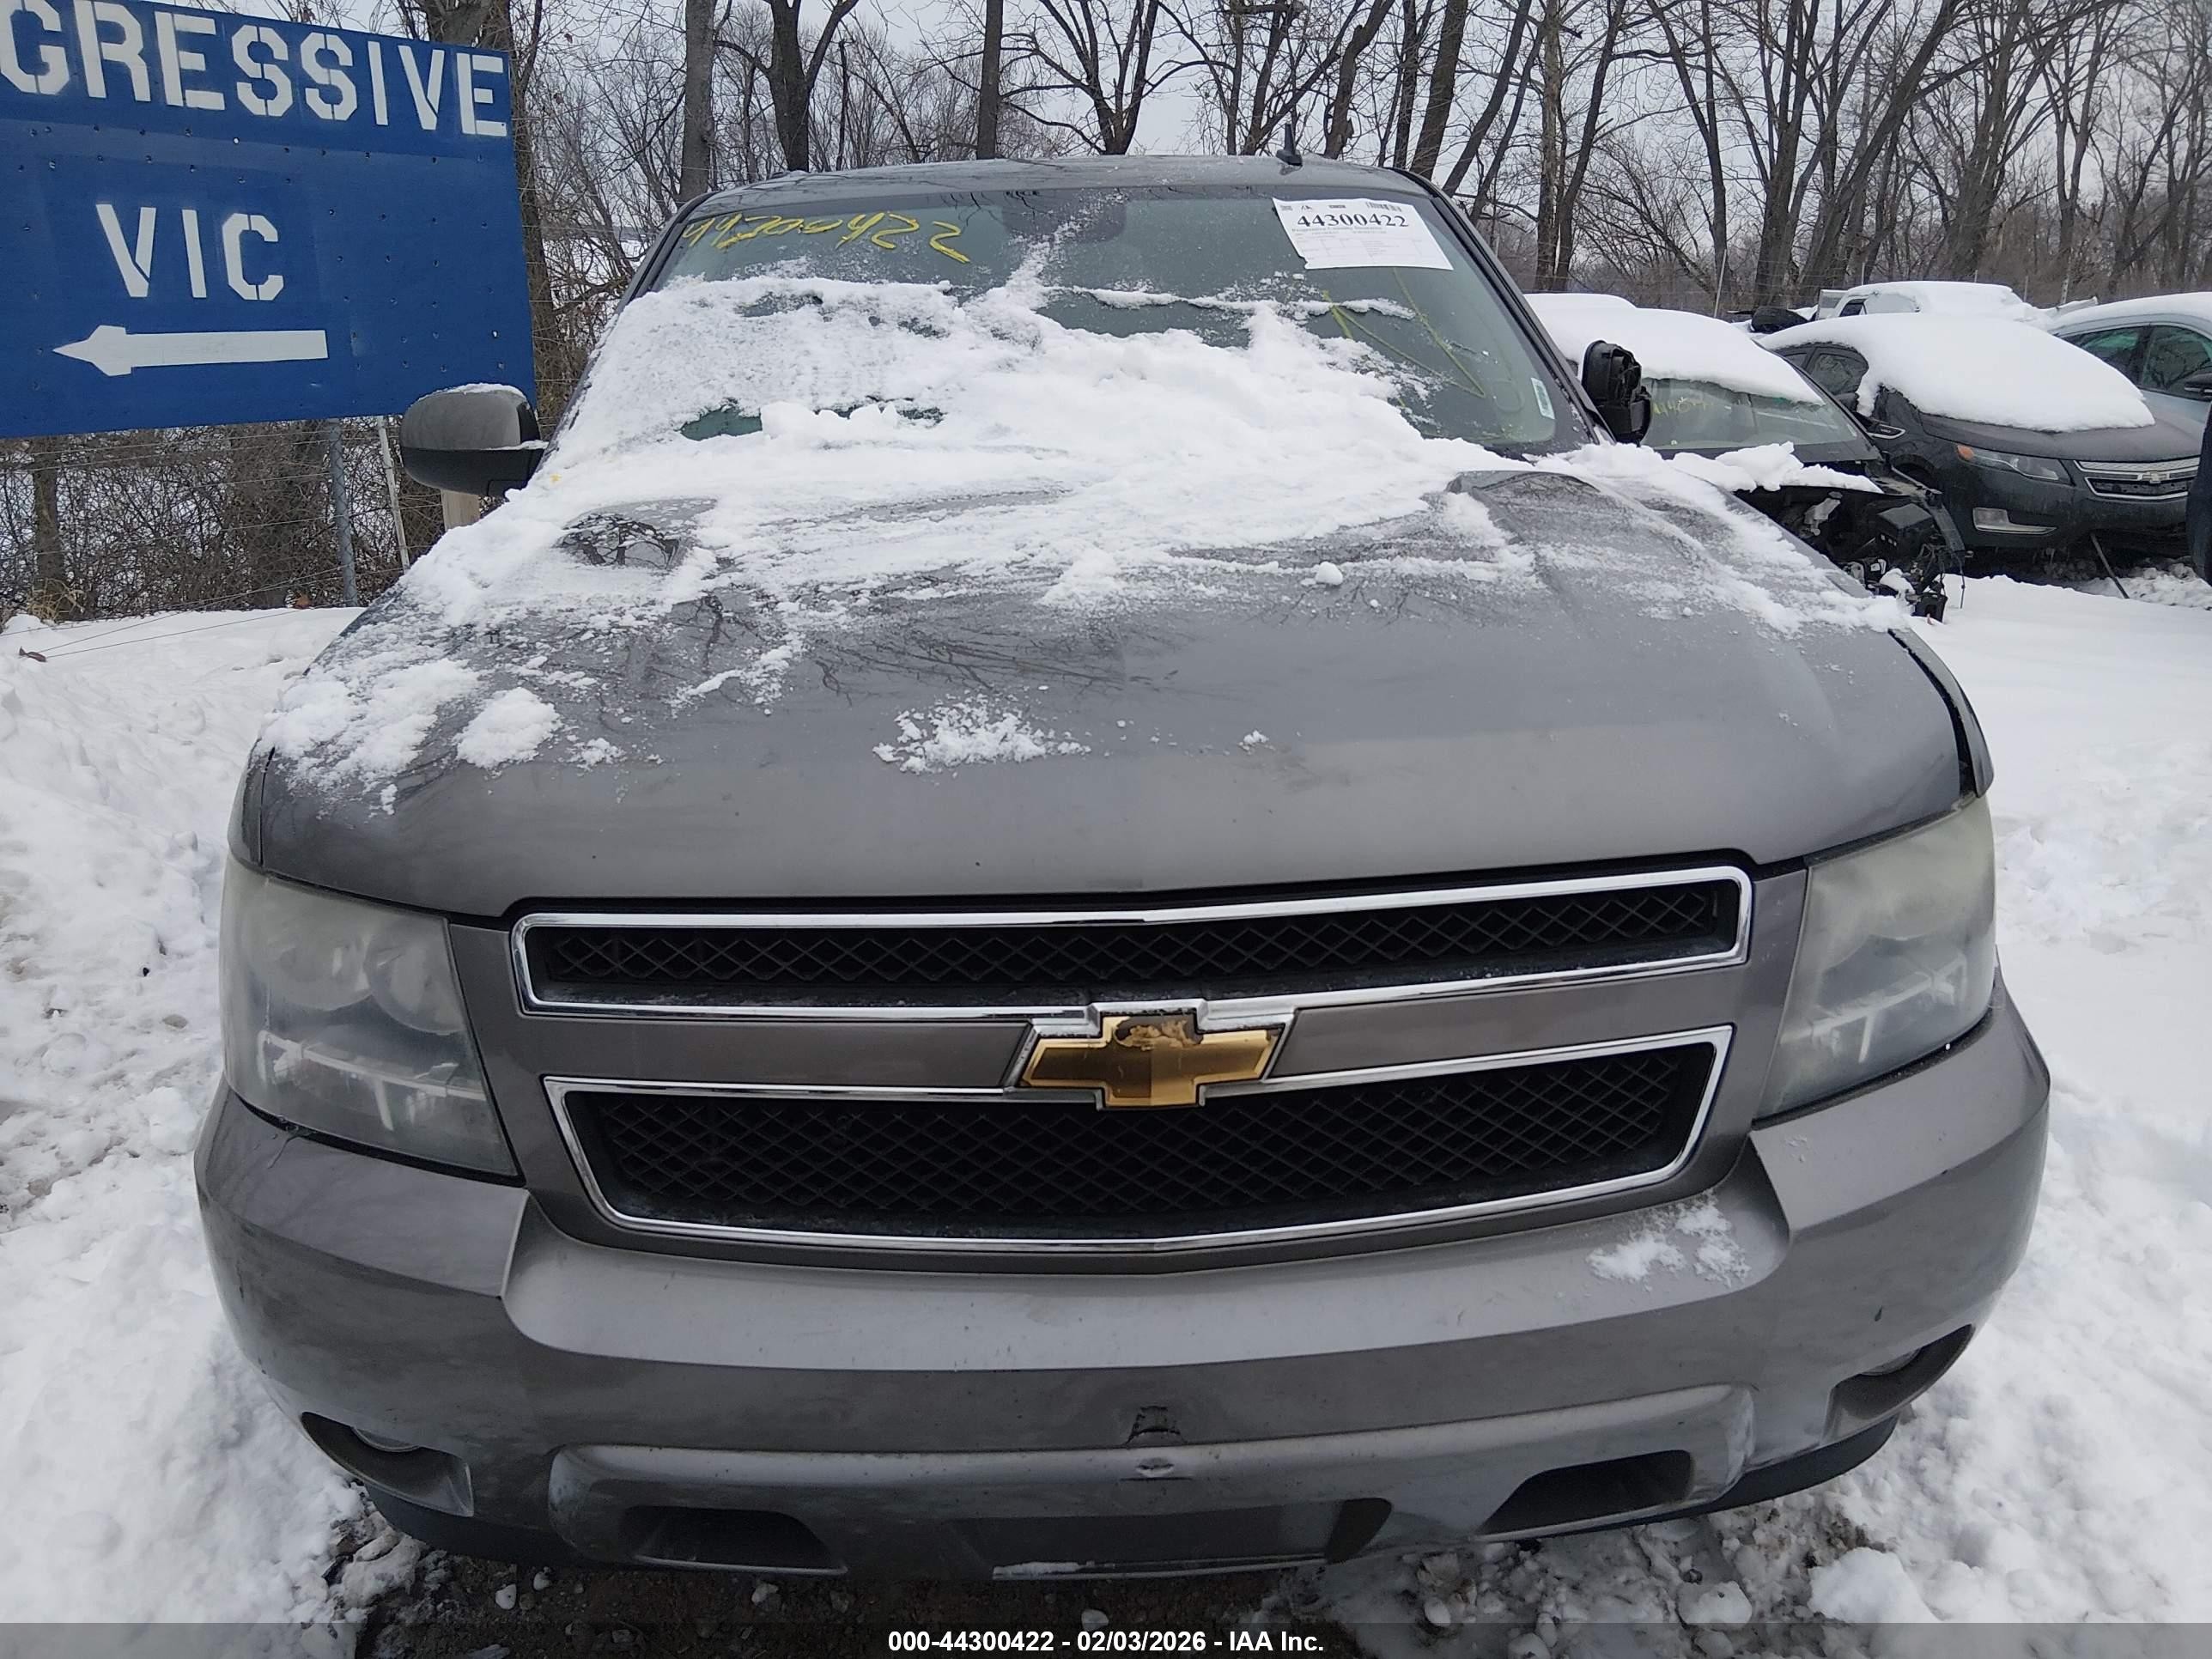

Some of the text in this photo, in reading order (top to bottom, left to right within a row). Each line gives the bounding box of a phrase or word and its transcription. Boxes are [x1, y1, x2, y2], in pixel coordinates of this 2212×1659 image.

[0, 0, 507, 137] GRESSIVE
[95, 204, 284, 301] VIC
[1297, 213, 1409, 228] 44300422
